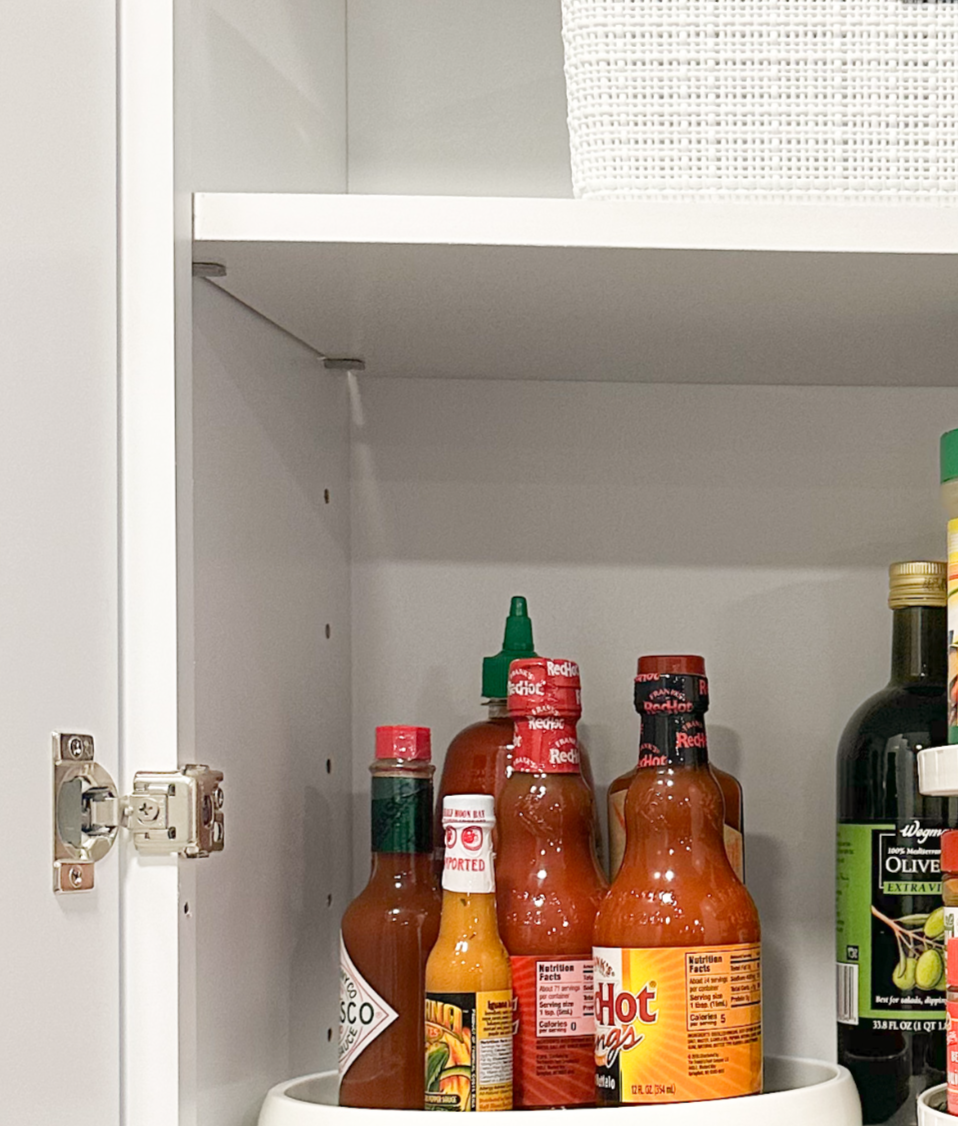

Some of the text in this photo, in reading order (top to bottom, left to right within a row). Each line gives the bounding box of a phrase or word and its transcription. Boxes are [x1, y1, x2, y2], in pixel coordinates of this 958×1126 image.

[885, 855, 941, 873] OLIVE
[887, 883, 926, 893] EXTRA
[688, 955, 723, 965] Nutrition
[539, 963, 575, 973] Nutrition
[689, 965, 711, 973] Facts
[539, 973, 561, 981] Facts
[720, 1013, 726, 1023] 5
[900, 1020, 912, 1030] OZ
[923, 1021, 937, 1032] QT
